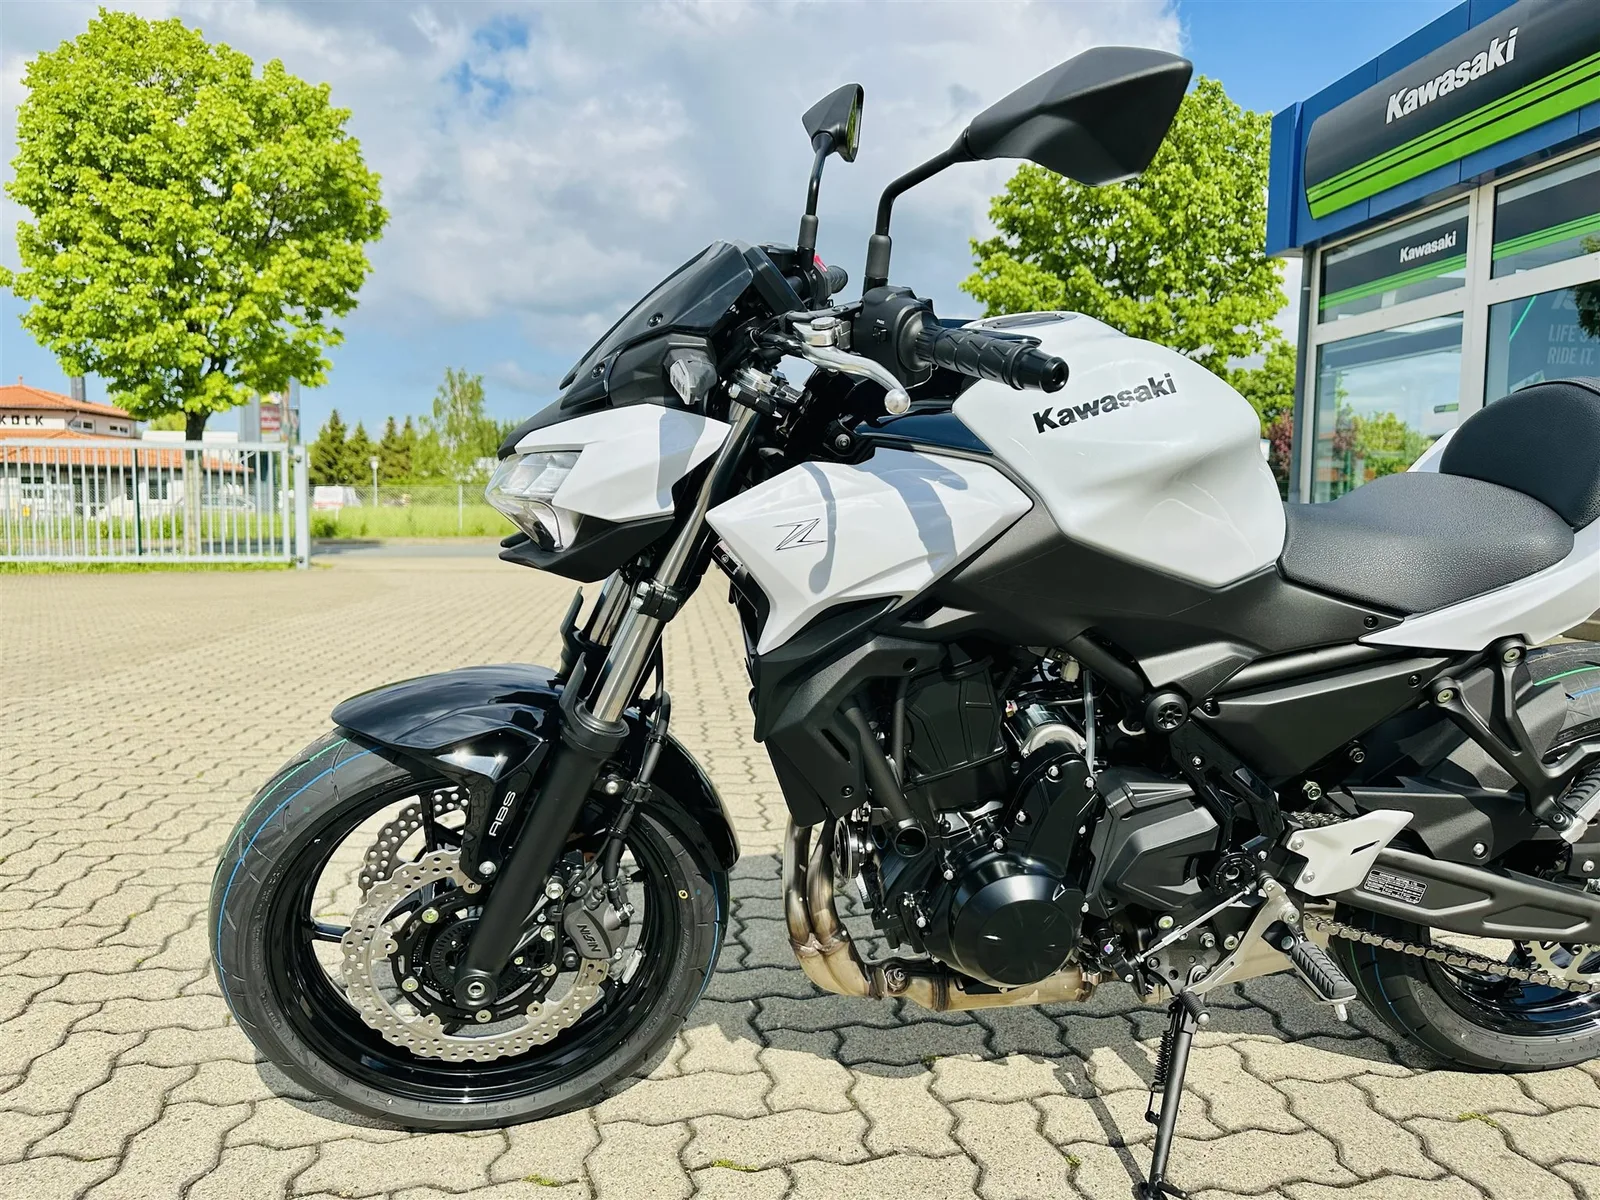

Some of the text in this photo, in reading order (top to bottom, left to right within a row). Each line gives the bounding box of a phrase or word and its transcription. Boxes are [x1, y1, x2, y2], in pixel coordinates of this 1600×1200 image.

[1386, 27, 1519, 124] Kawasaki
[1400, 230, 1457, 263] Kawasaki
[1547, 346, 1578, 365] RIDE
[1032, 372, 1177, 434] Kawasaki
[489, 791, 516, 836] ABS
